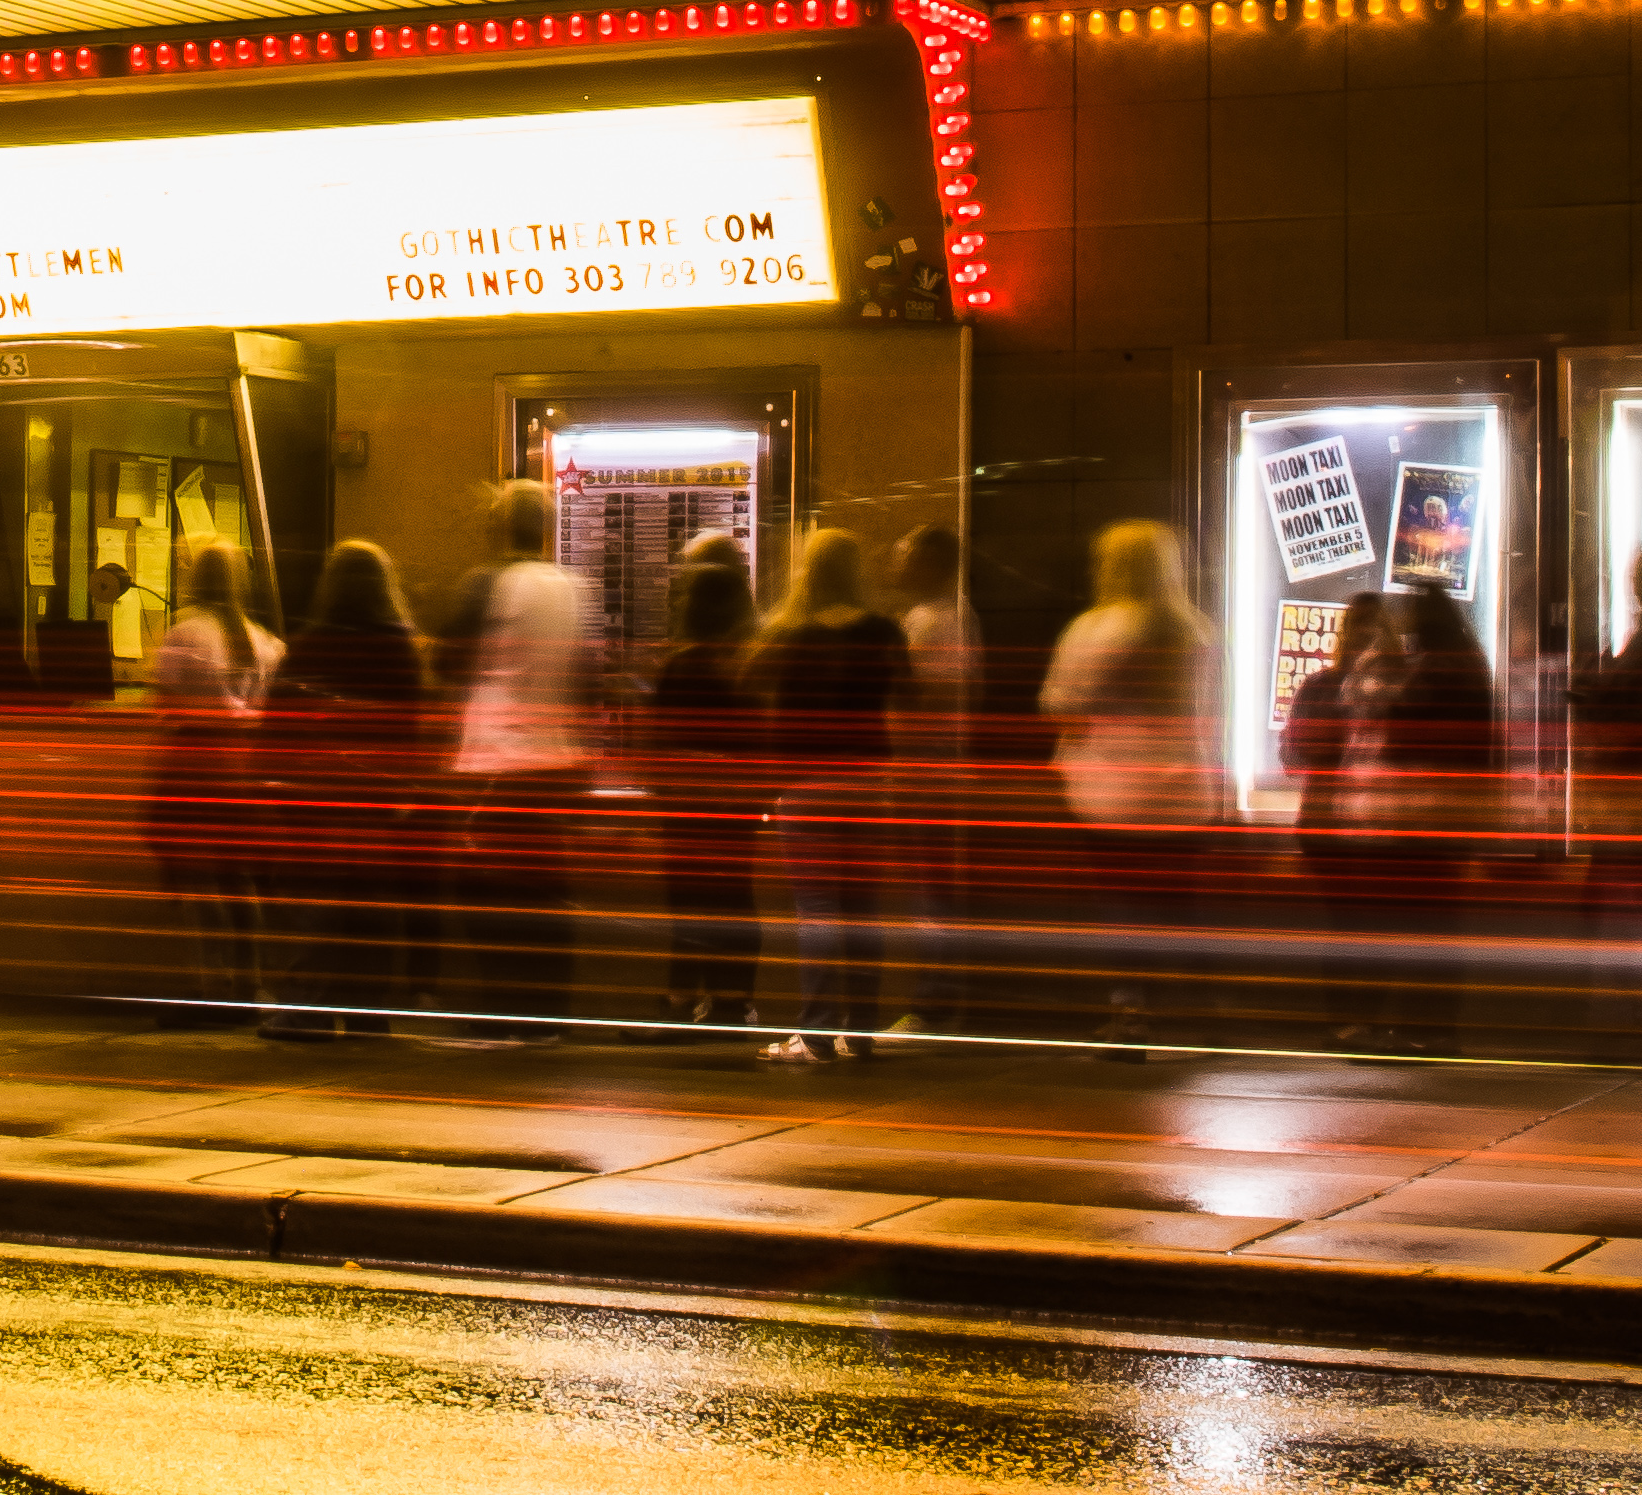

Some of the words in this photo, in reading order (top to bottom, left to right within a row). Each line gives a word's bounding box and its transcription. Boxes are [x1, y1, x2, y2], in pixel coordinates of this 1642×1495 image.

[400, 217, 682, 259] GOTHICTHEATRE
[704, 211, 776, 243] COM
[386, 272, 448, 302] FOR
[466, 267, 545, 298] INFO
[565, 263, 625, 293] 303
[637, 260, 698, 290] 789
[719, 253, 806, 286] 9206
[583, 467, 687, 485] SUMMER
[1265, 453, 1310, 486] MOON
[1309, 444, 1344, 473] TAXI
[1272, 481, 1318, 514] MOON
[1316, 473, 1351, 502] TAXI
[1280, 509, 1325, 542] MOON
[1323, 500, 1359, 529] TAXI
[1287, 531, 1353, 557] NOVEMBER
[1292, 550, 1326, 569] GOTHIC
[1326, 540, 1367, 559] THEATRE
[1281, 629, 1338, 654] ROO
